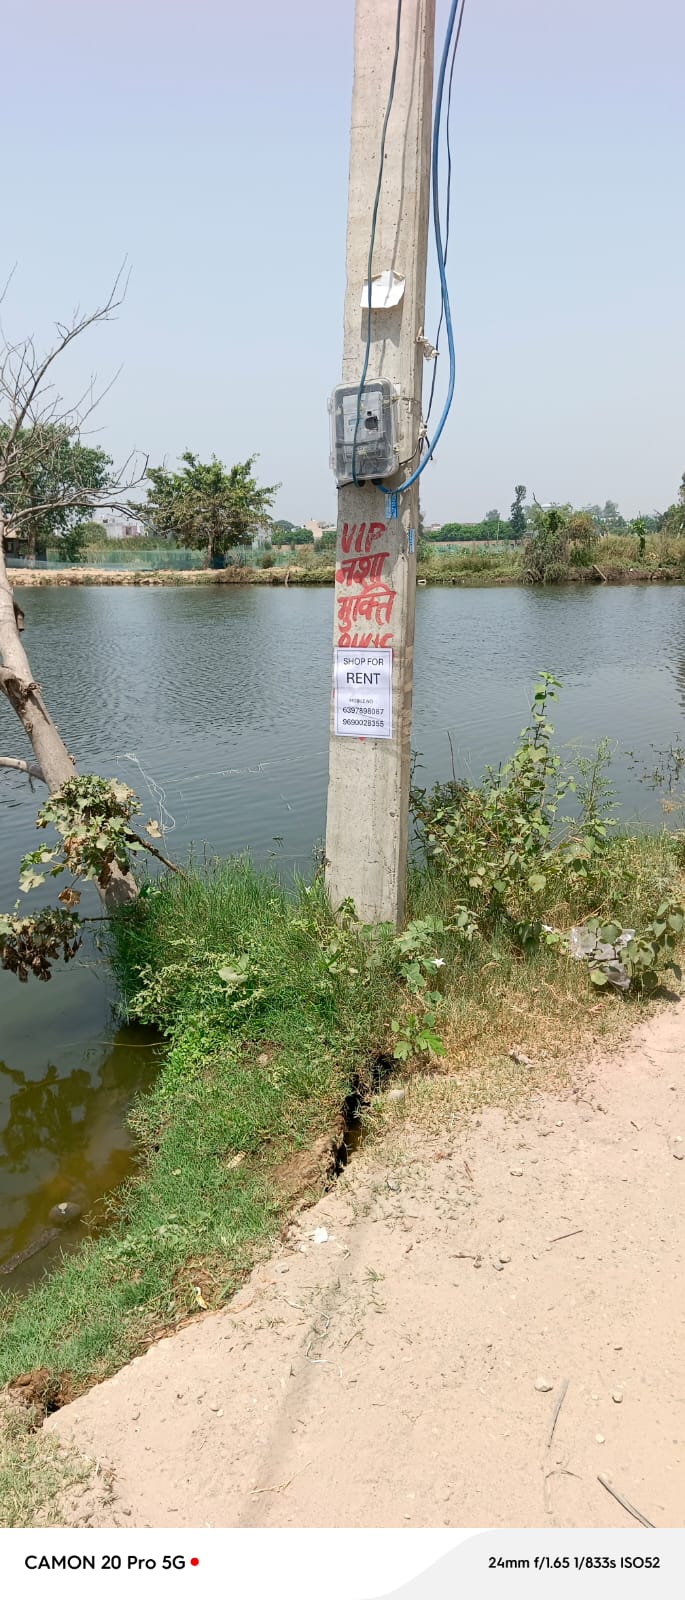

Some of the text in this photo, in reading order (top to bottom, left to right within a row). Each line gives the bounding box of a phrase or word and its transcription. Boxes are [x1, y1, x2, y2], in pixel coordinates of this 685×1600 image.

[341, 522, 387, 553] VIP
[335, 552, 390, 587] नशा
[337, 583, 397, 633] मुक्ति
[343, 657, 384, 666] SHOP FOR
[346, 672, 381, 685] RENT
